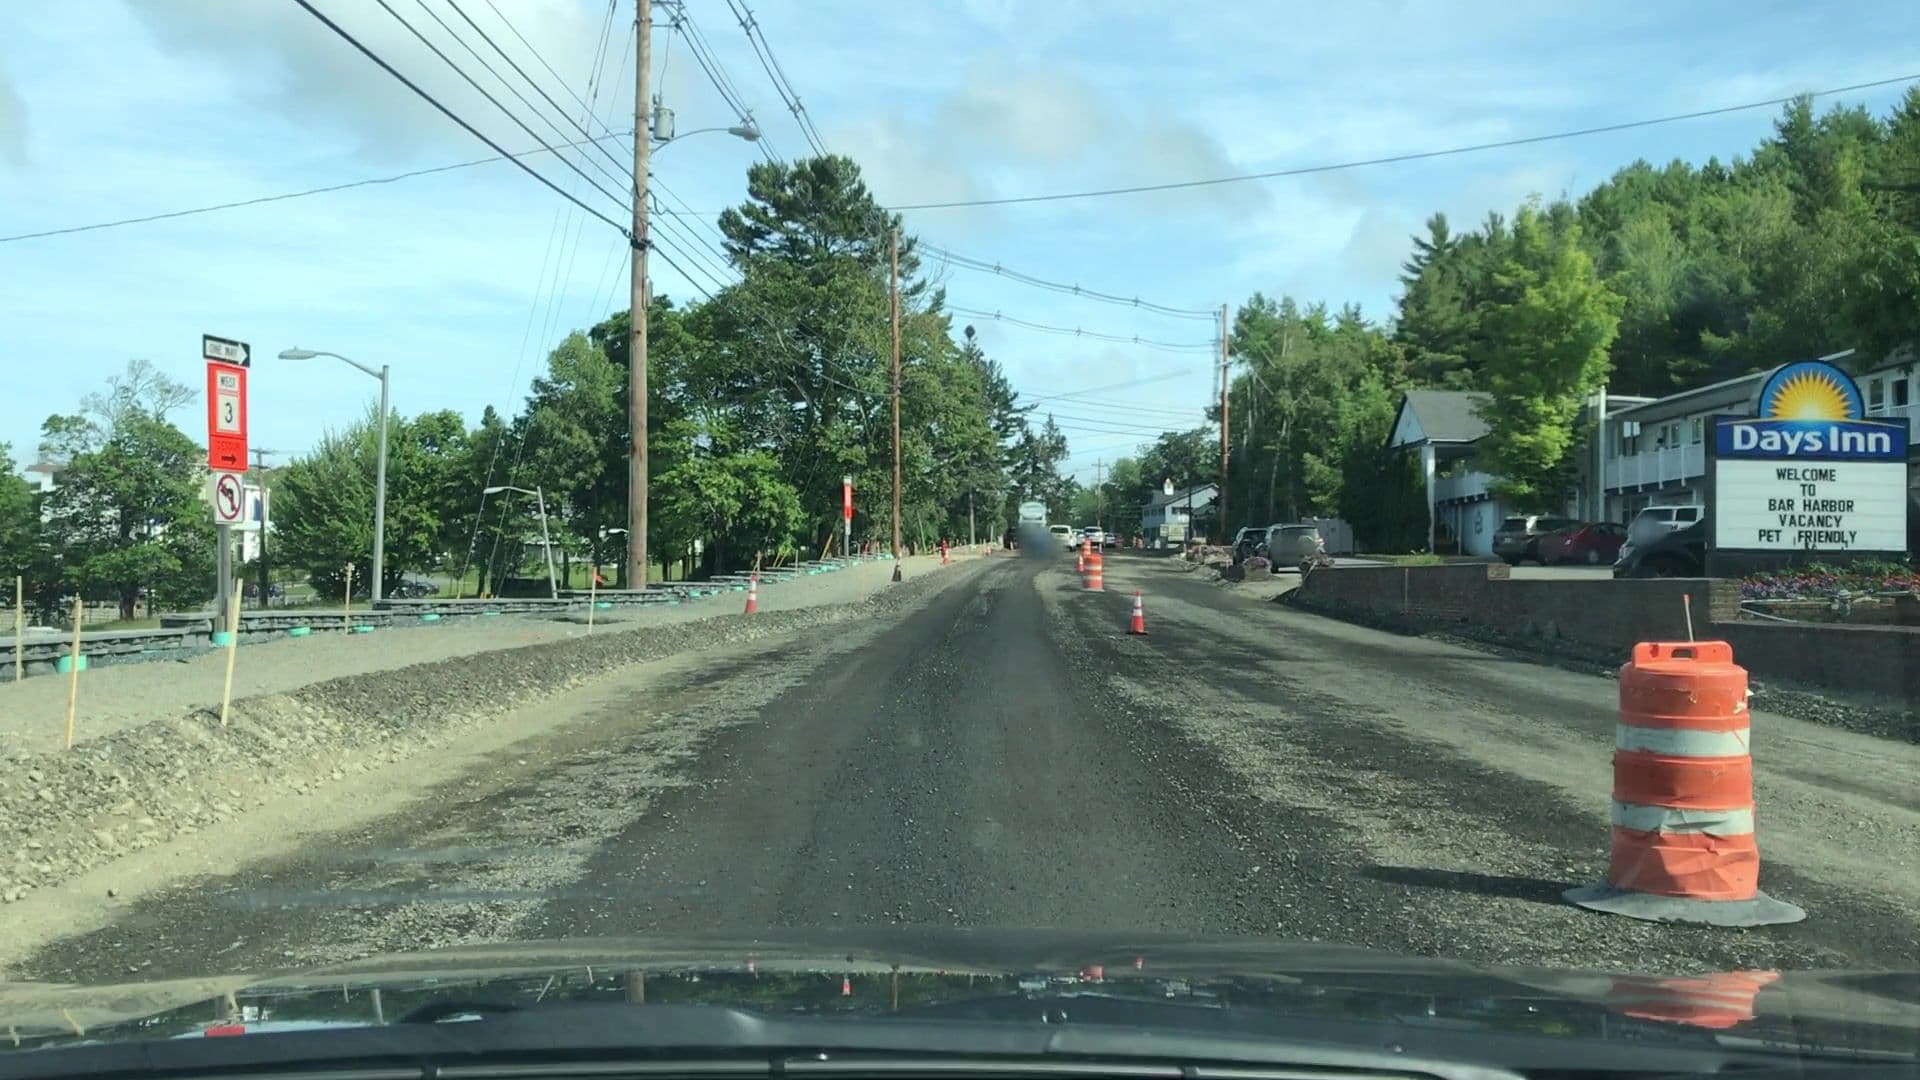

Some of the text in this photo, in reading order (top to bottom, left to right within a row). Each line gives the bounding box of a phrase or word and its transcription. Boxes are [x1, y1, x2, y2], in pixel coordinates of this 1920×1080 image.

[225, 402, 233, 423] 3
[1733, 425, 1891, 455] Days Inn
[1776, 468, 1837, 482] WELCOME
[1800, 483, 1816, 497] TO
[1768, 499, 1854, 513] BAR HARBOR
[1779, 514, 1843, 528] VACANCY
[1758, 529, 1857, 544] PET FRIENDLY
